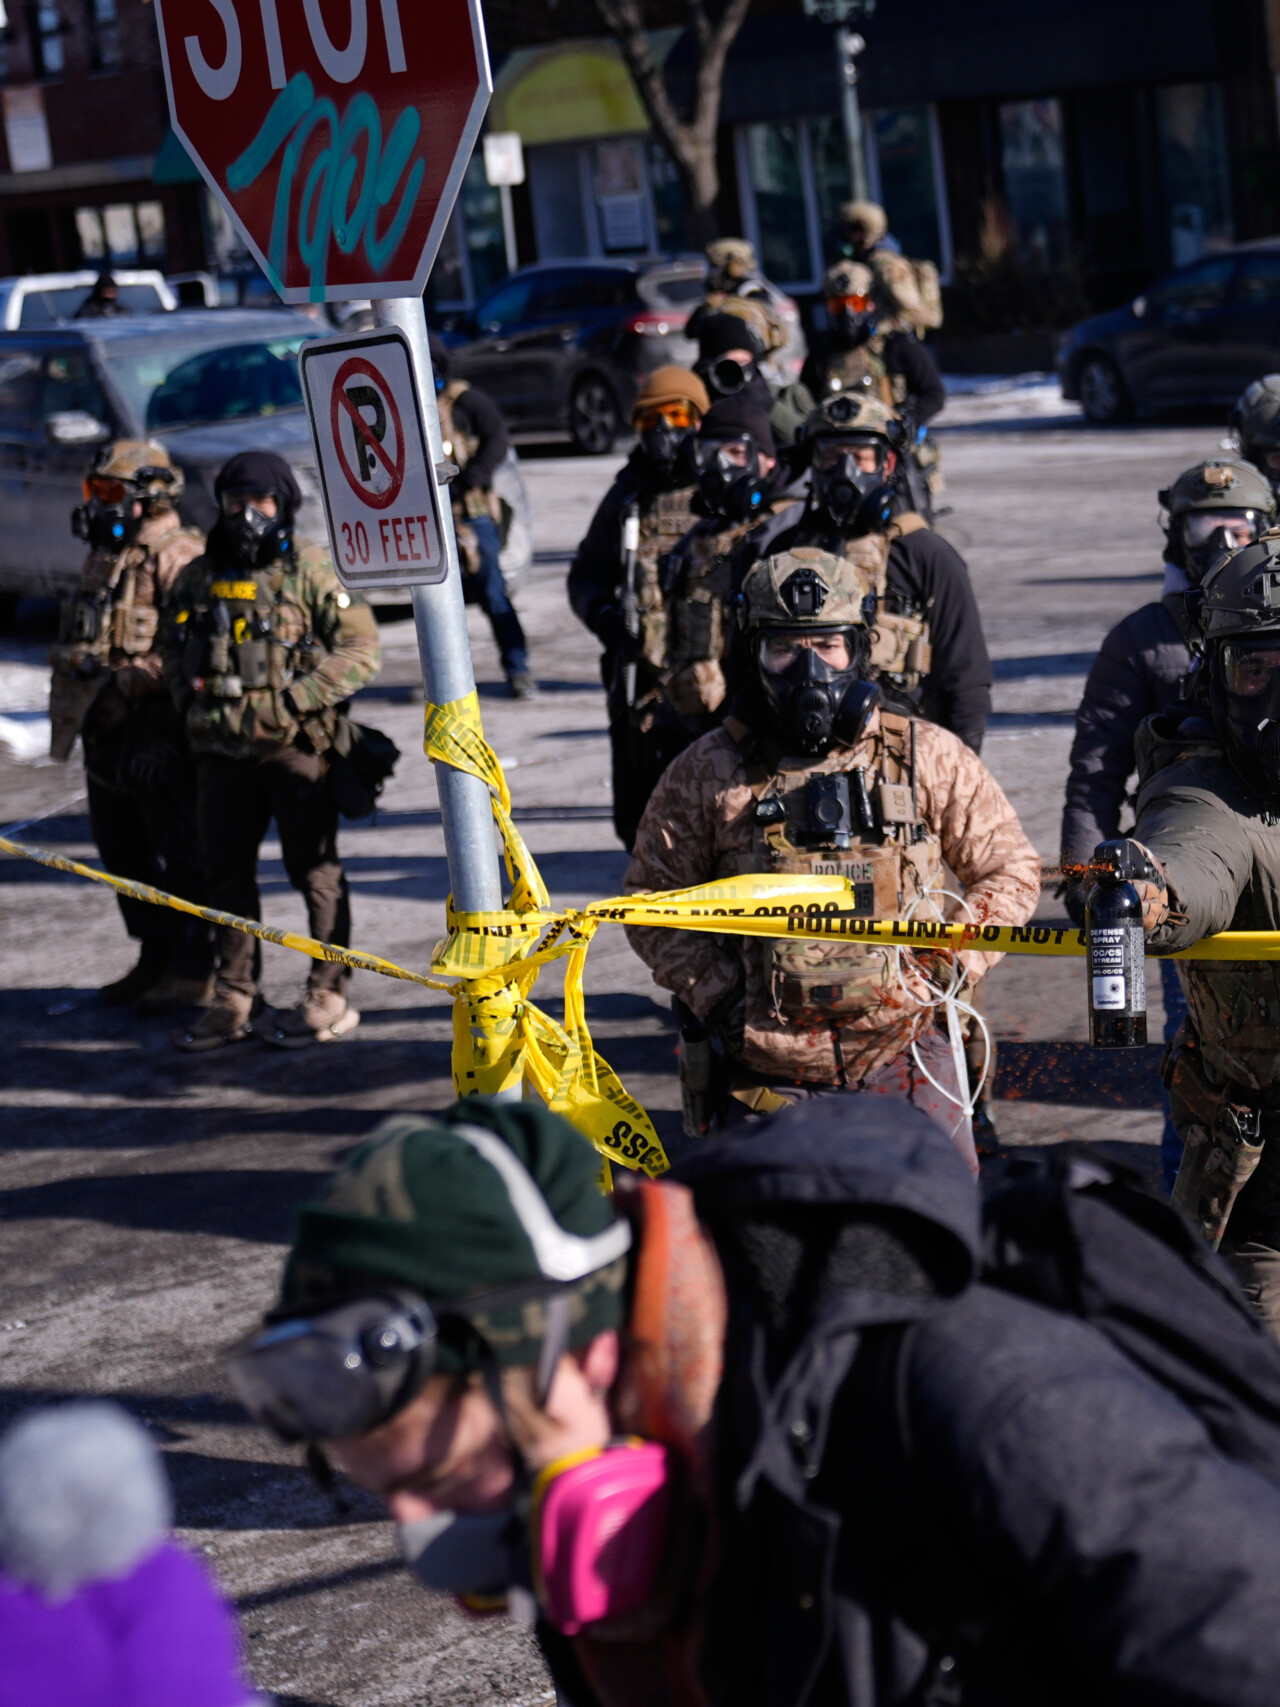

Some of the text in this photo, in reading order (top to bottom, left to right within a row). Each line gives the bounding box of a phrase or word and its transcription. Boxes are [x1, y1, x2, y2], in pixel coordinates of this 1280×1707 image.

[341, 515, 431, 566] 30 FEET
[891, 921, 953, 939] LINE
[1090, 928, 1125, 936] DEFENSE
[1092, 936, 1121, 944] SPRAY
[1093, 948, 1122, 957] OC/CS
